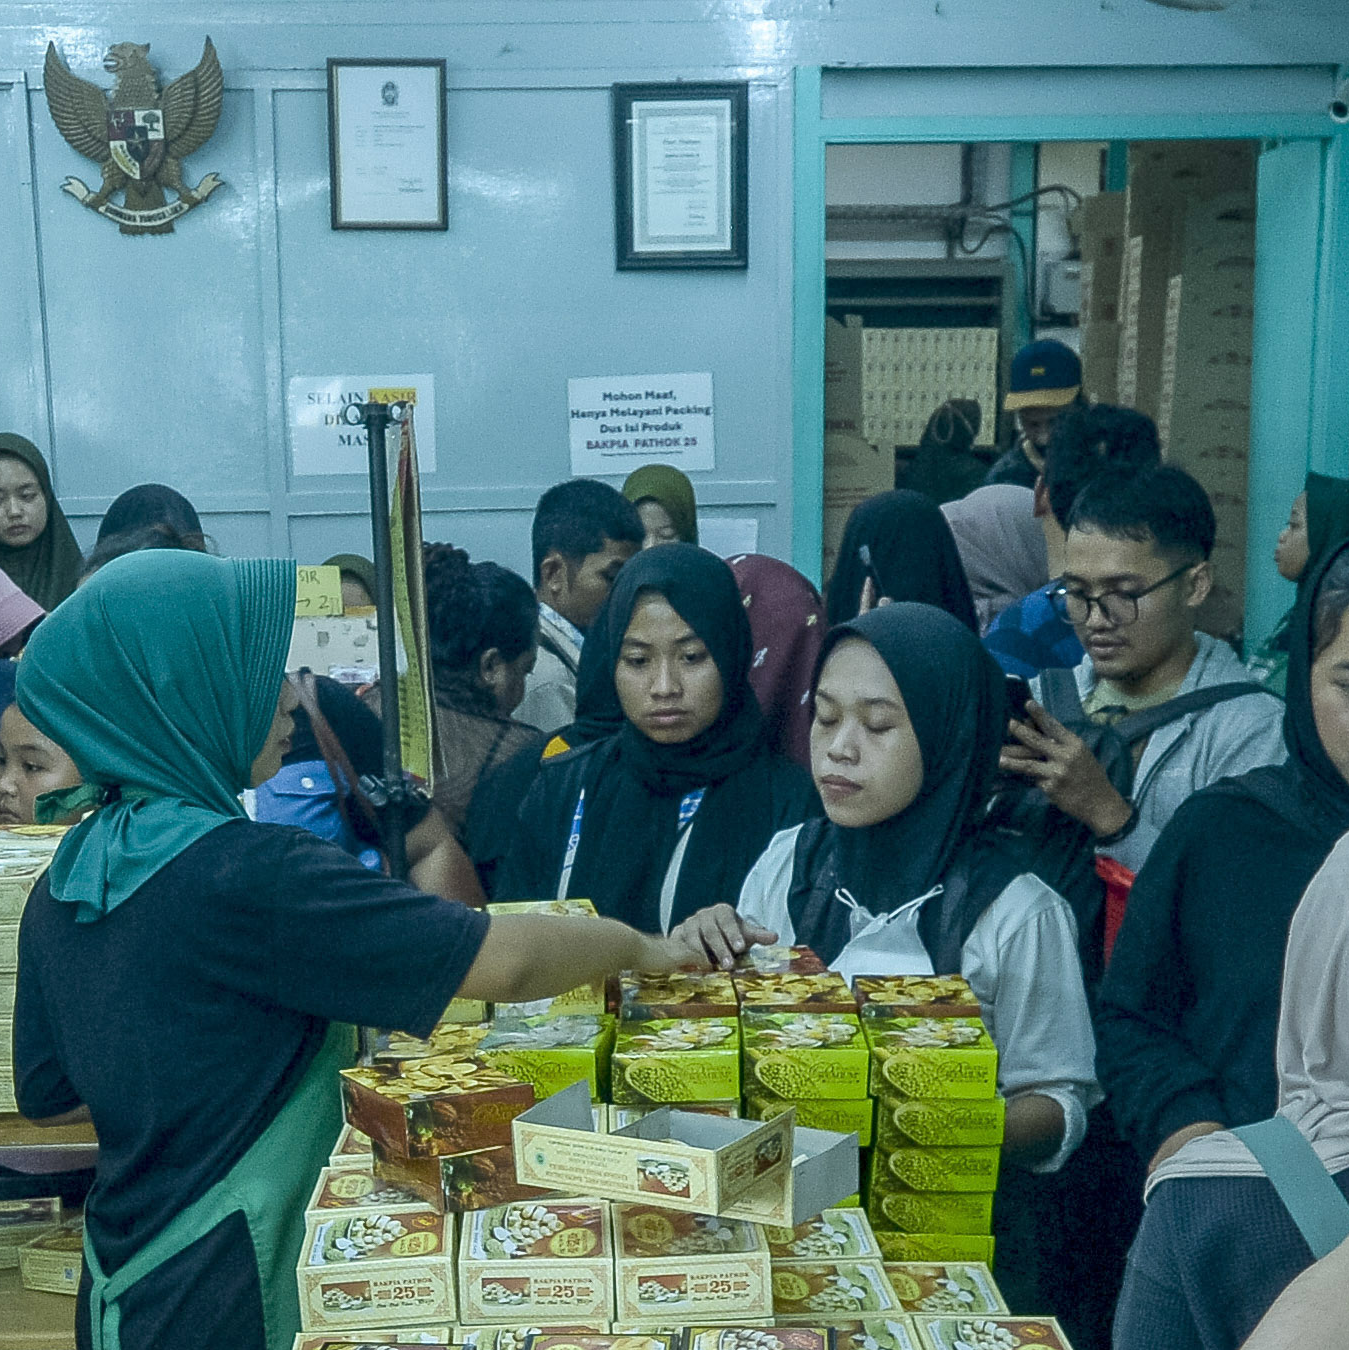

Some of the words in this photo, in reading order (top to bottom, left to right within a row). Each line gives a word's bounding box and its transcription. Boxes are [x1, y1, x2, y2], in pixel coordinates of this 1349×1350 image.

[307, 391, 364, 404] SELAIN
[369, 391, 416, 403] KASIR
[602, 392, 642, 401] Mohon
[645, 390, 677, 400] Maaf,
[571, 409, 607, 419] Hanya
[610, 407, 663, 418] Melayani
[665, 405, 712, 416] Packing
[600, 424, 622, 433] Dus
[625, 423, 639, 432] Isi
[642, 422, 682, 431] Produk
[586, 440, 629, 449] BAKPIA
[634, 437, 681, 448] PATHOK
[683, 436, 698, 447] 25
[298, 570, 321, 584] SIR
[393, 1286, 416, 1300] 25
[552, 1285, 575, 1298] 25
[709, 1280, 732, 1294] 25
